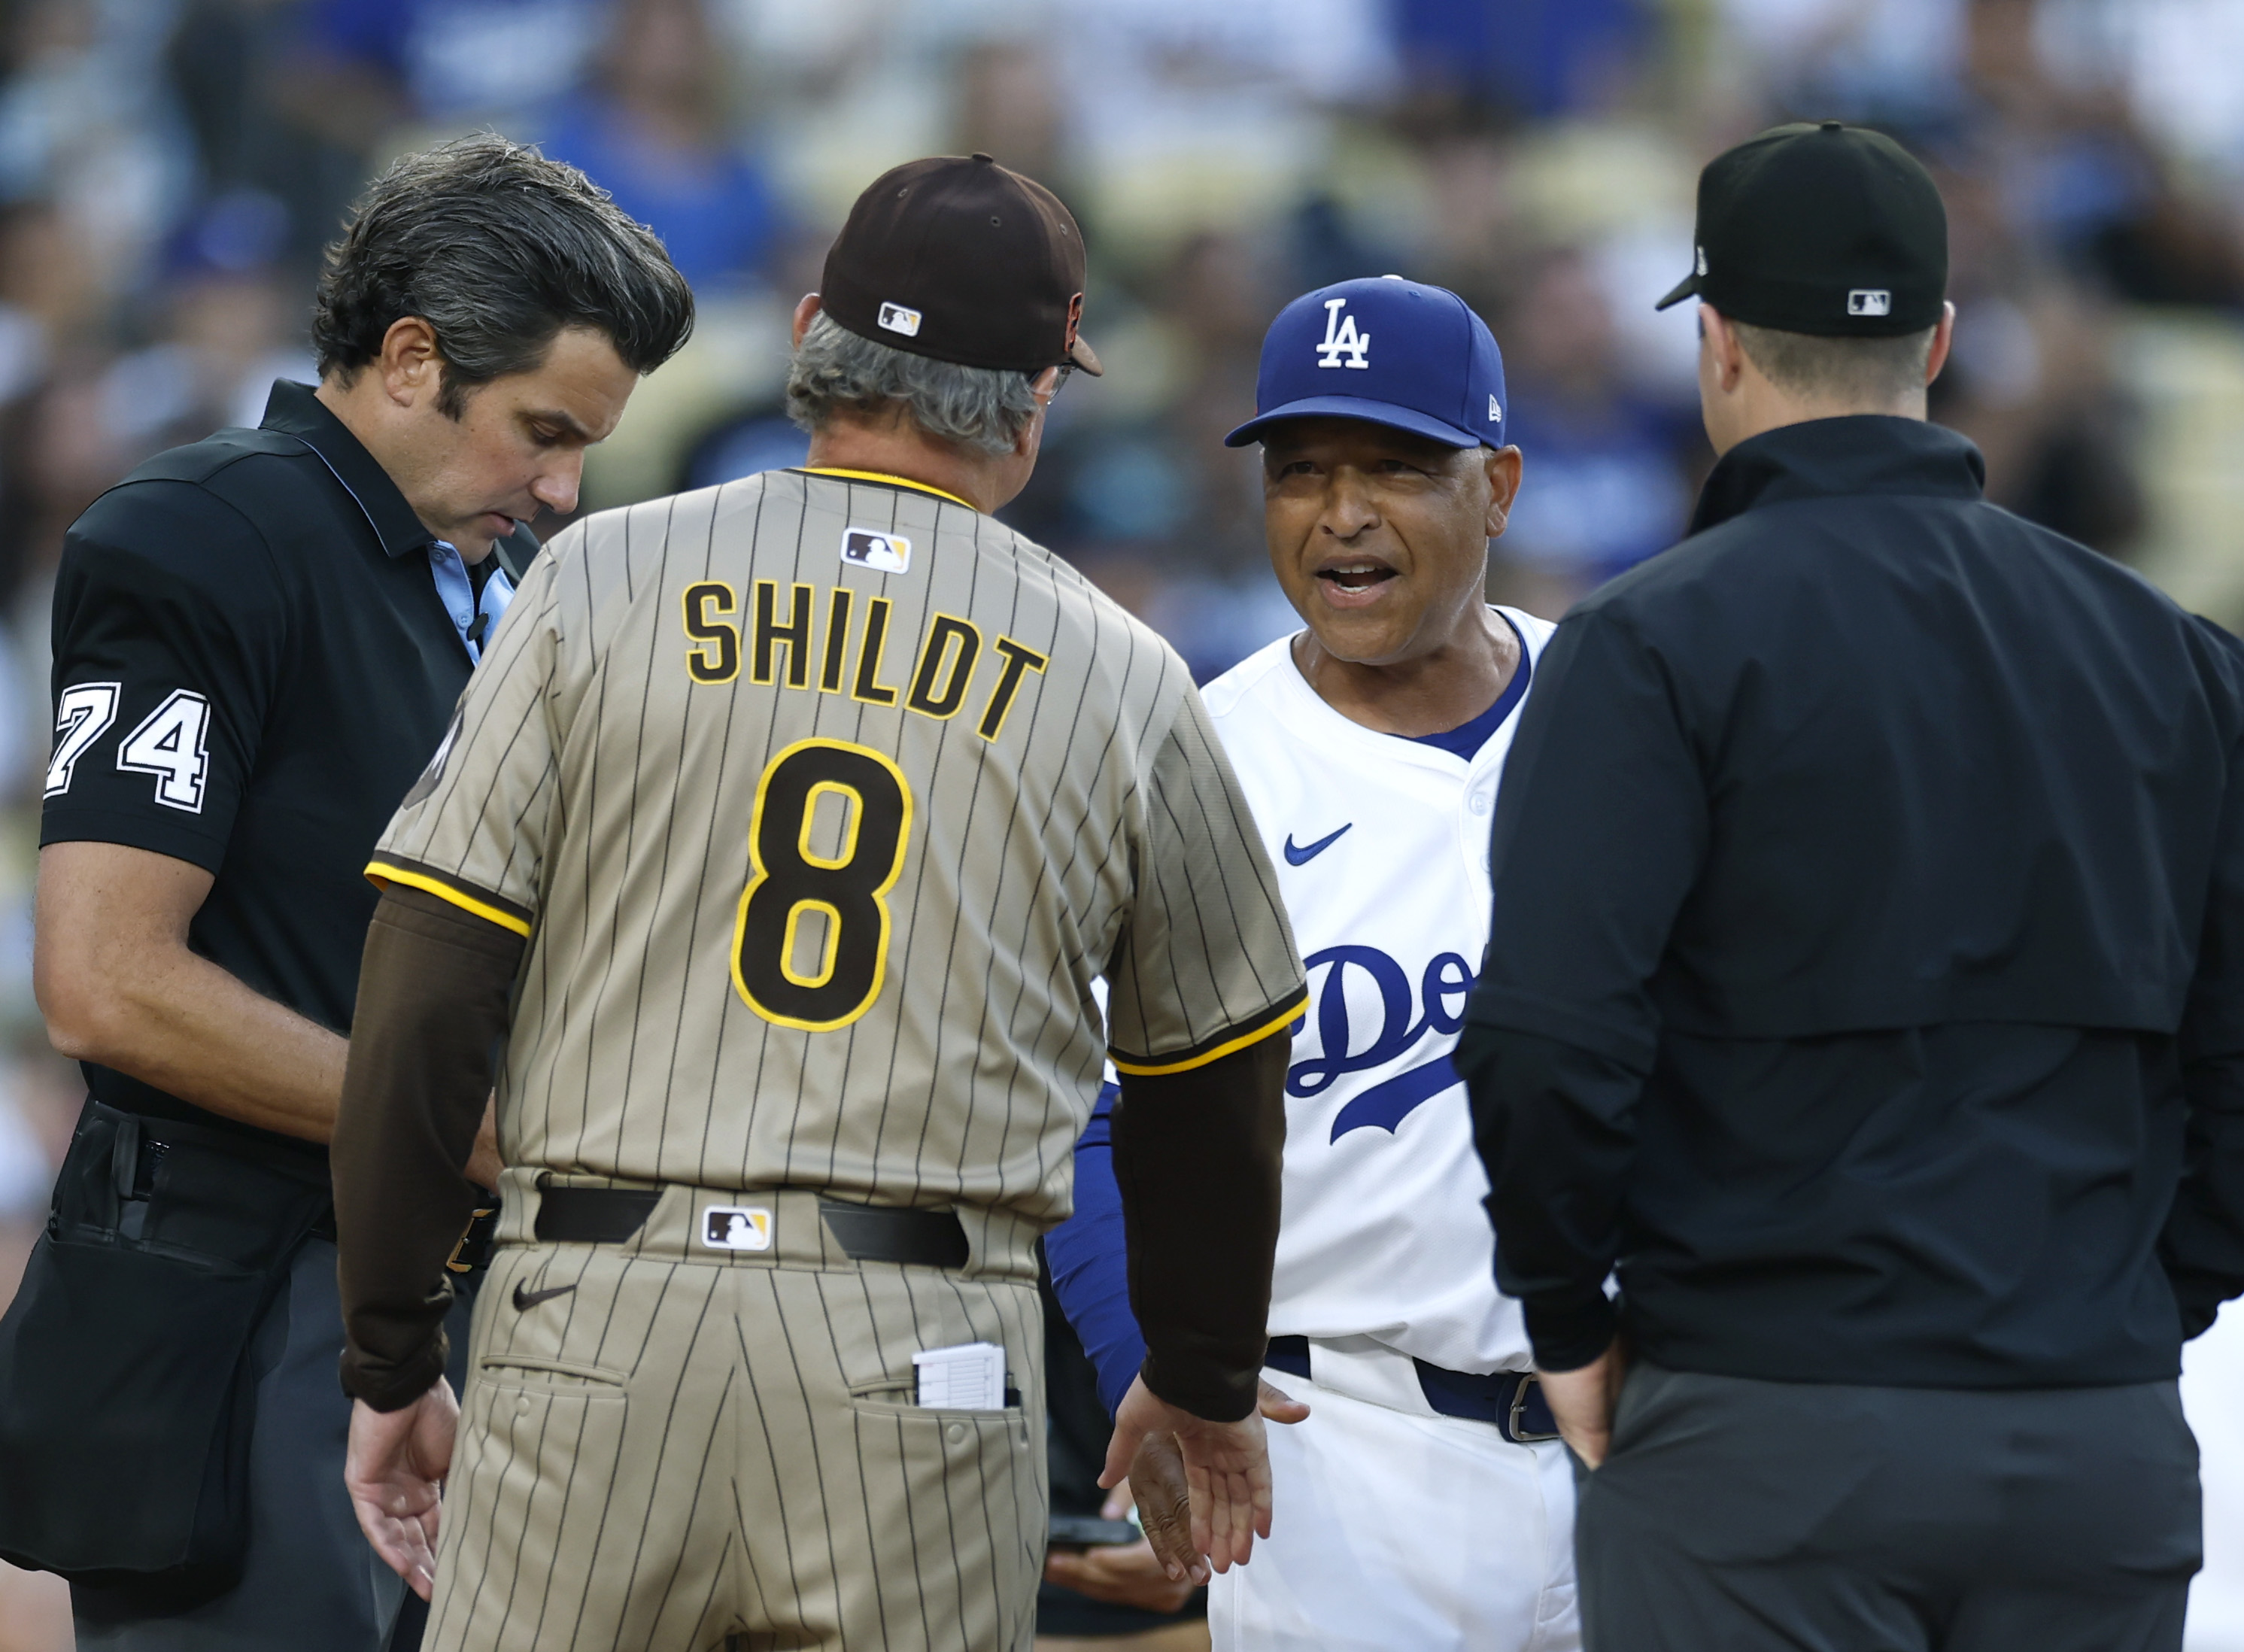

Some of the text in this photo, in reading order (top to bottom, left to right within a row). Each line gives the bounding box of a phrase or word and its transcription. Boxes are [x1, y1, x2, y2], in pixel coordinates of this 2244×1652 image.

[1316, 298, 1370, 369] LA
[682, 579, 1049, 743] SHILDT
[43, 682, 211, 815] 74
[730, 737, 914, 1033] 8
[1285, 945, 1483, 1098] Do
